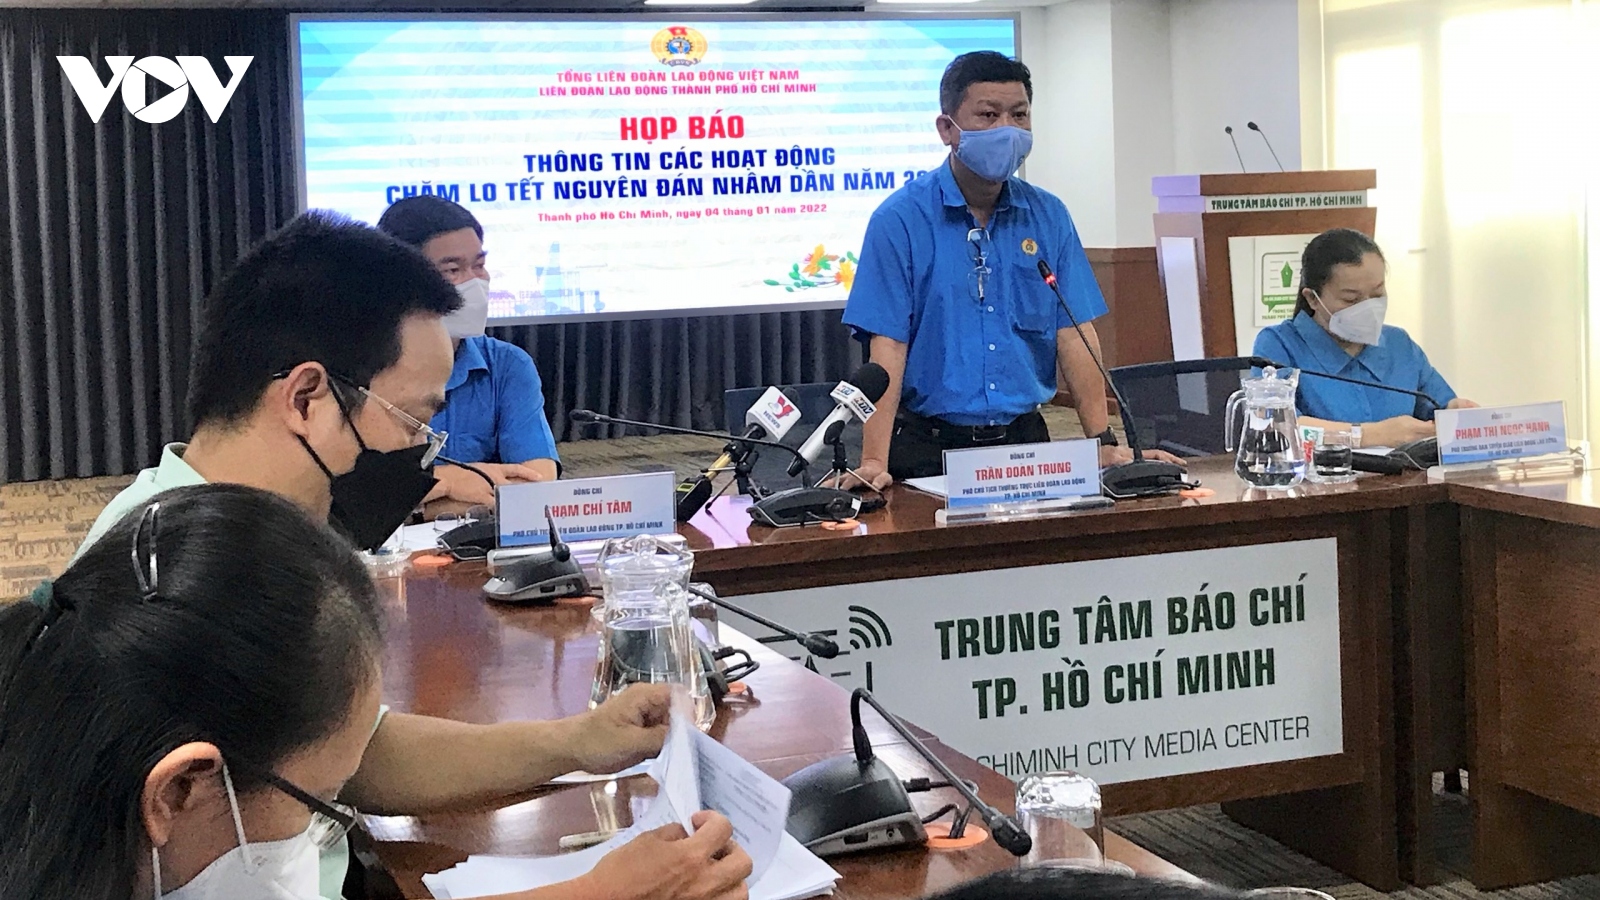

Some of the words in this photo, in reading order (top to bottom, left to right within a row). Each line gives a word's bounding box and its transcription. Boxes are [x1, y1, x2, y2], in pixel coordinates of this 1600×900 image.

[557, 69, 592, 82] TỔNG
[597, 70, 626, 82] LIÊN
[631, 69, 666, 82] ĐOÀN
[671, 71, 694, 81] LAO
[699, 70, 734, 82] ĐỘNG
[739, 69, 764, 81] VIỆT
[769, 70, 799, 80] NAM
[540, 85, 566, 96] LIÊN
[609, 86, 631, 96] LAO
[635, 85, 668, 96] ĐỘNG
[672, 84, 711, 94] THÀNH
[784, 84, 816, 93] MINH
[620, 116, 677, 145] HỌP
[688, 109, 744, 139] BÁO
[523, 150, 603, 173] THÔNG
[611, 152, 650, 171] TIN
[660, 146, 702, 170] CÁC
[712, 149, 767, 171] HOẠT
[775, 145, 835, 170] ĐỘNG
[469, 183, 497, 202] LO
[506, 176, 544, 201] TẾT
[554, 175, 647, 200] NGUYÊN
[656, 173, 703, 197] ĐÁN
[713, 172, 781, 195] NHÂM
[790, 169, 834, 193] DẦN
[843, 168, 895, 190] NĂM
[640, 209, 672, 219] Minh,
[705, 207, 719, 216] 04
[723, 207, 753, 217] tháng
[756, 206, 770, 215] 01
[800, 203, 827, 213] 2022
[1211, 199, 1239, 210] TRUNG
[1240, 196, 1258, 209] TÂM
[1260, 195, 1277, 208] BÁO
[1295, 196, 1308, 207] TP.
[1339, 195, 1362, 206] MINH
[763, 410, 781, 429] NEWS
[975, 465, 1003, 481] TRẦN
[1006, 463, 1035, 479] ĐOÀN
[1037, 461, 1071, 475] TRUNG
[583, 500, 602, 517] CHÍ
[607, 499, 632, 514] TÂM
[934, 609, 1060, 660] TRUNG
[1072, 595, 1152, 645] TÂM
[1167, 582, 1235, 635] BÁO
[1249, 572, 1308, 627] CHÍ
[972, 677, 1028, 719] TP.
[1042, 657, 1090, 712] HỒ
[1104, 648, 1165, 704] CHÍ
[1177, 648, 1275, 696] MINH
[1087, 737, 1136, 766] CITY
[1145, 727, 1217, 758] MEDIA
[1225, 715, 1309, 748] CENTER
